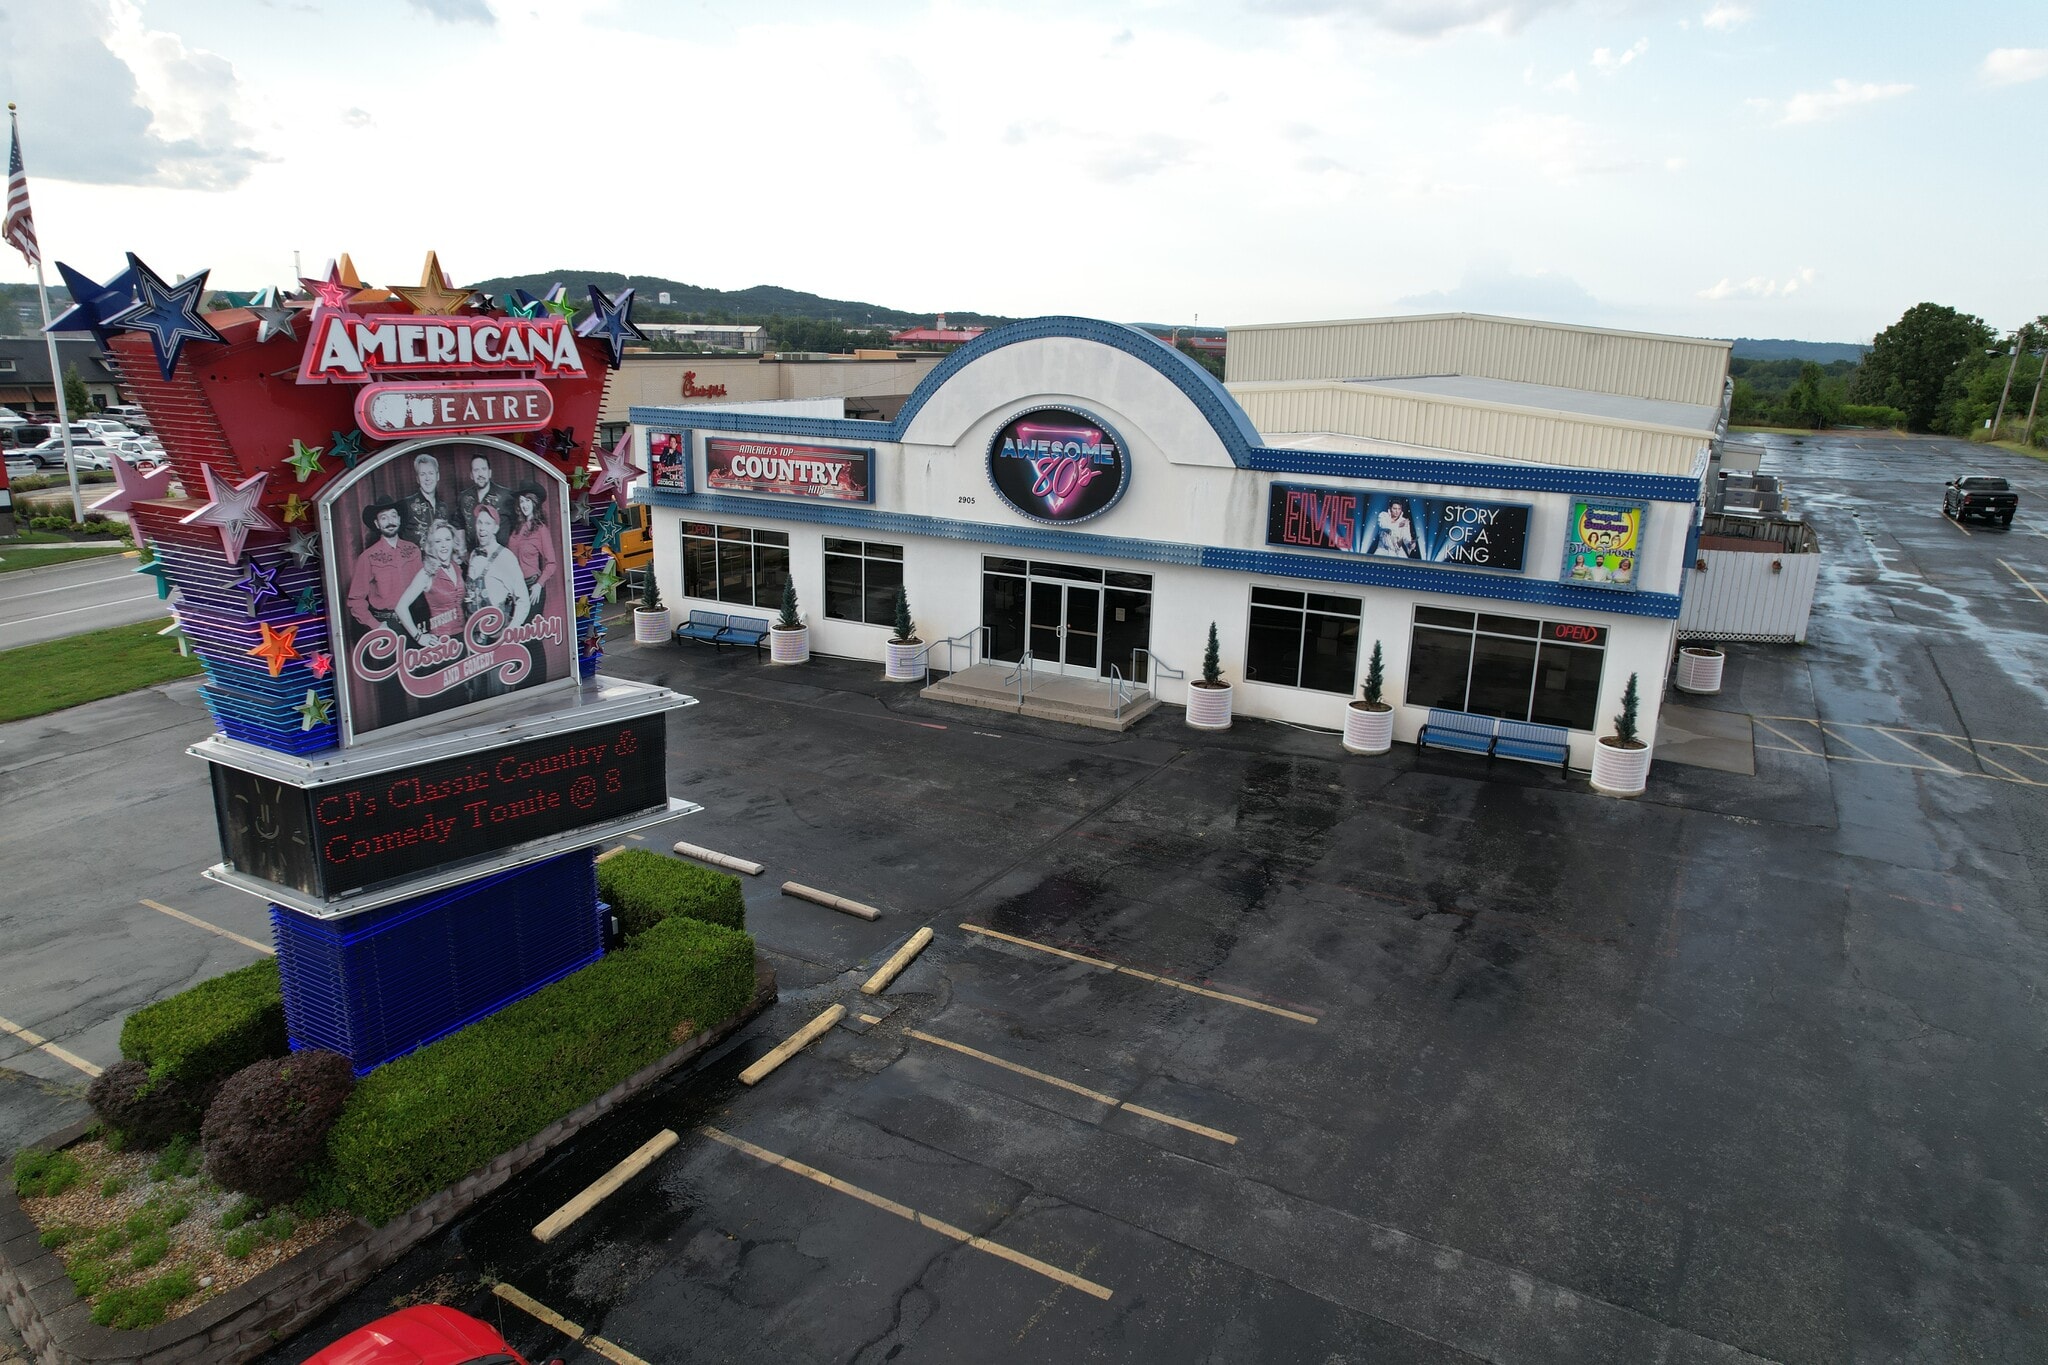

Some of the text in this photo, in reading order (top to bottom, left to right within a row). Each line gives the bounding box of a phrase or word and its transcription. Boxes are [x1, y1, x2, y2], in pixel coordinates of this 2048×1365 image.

[319, 317, 584, 373] AMERICANA
[373, 393, 540, 429] EATRE
[739, 445, 794, 456] AMERICA'S TOP
[1000, 437, 1115, 466] AWESOME
[731, 455, 843, 486] COUNTRY
[808, 485, 824, 495] HITS
[958, 496, 976, 504] 2905
[1283, 491, 1357, 550] ELVIS
[1443, 505, 1499, 526] STORY
[1584, 519, 1628, 534] Sundays
[692, 524, 709, 535] OPEN
[1448, 525, 1489, 544] OF A
[1445, 545, 1490, 563] KING
[353, 606, 562, 682] Classic Country
[1555, 624, 1591, 640] OPEN
[443, 650, 495, 687] AND COMEDY
[388, 766, 489, 808] Classic
[496, 744, 608, 783] Country
[615, 730, 637, 756] &
[325, 767, 621, 864] Comedy Tonite @ 8
